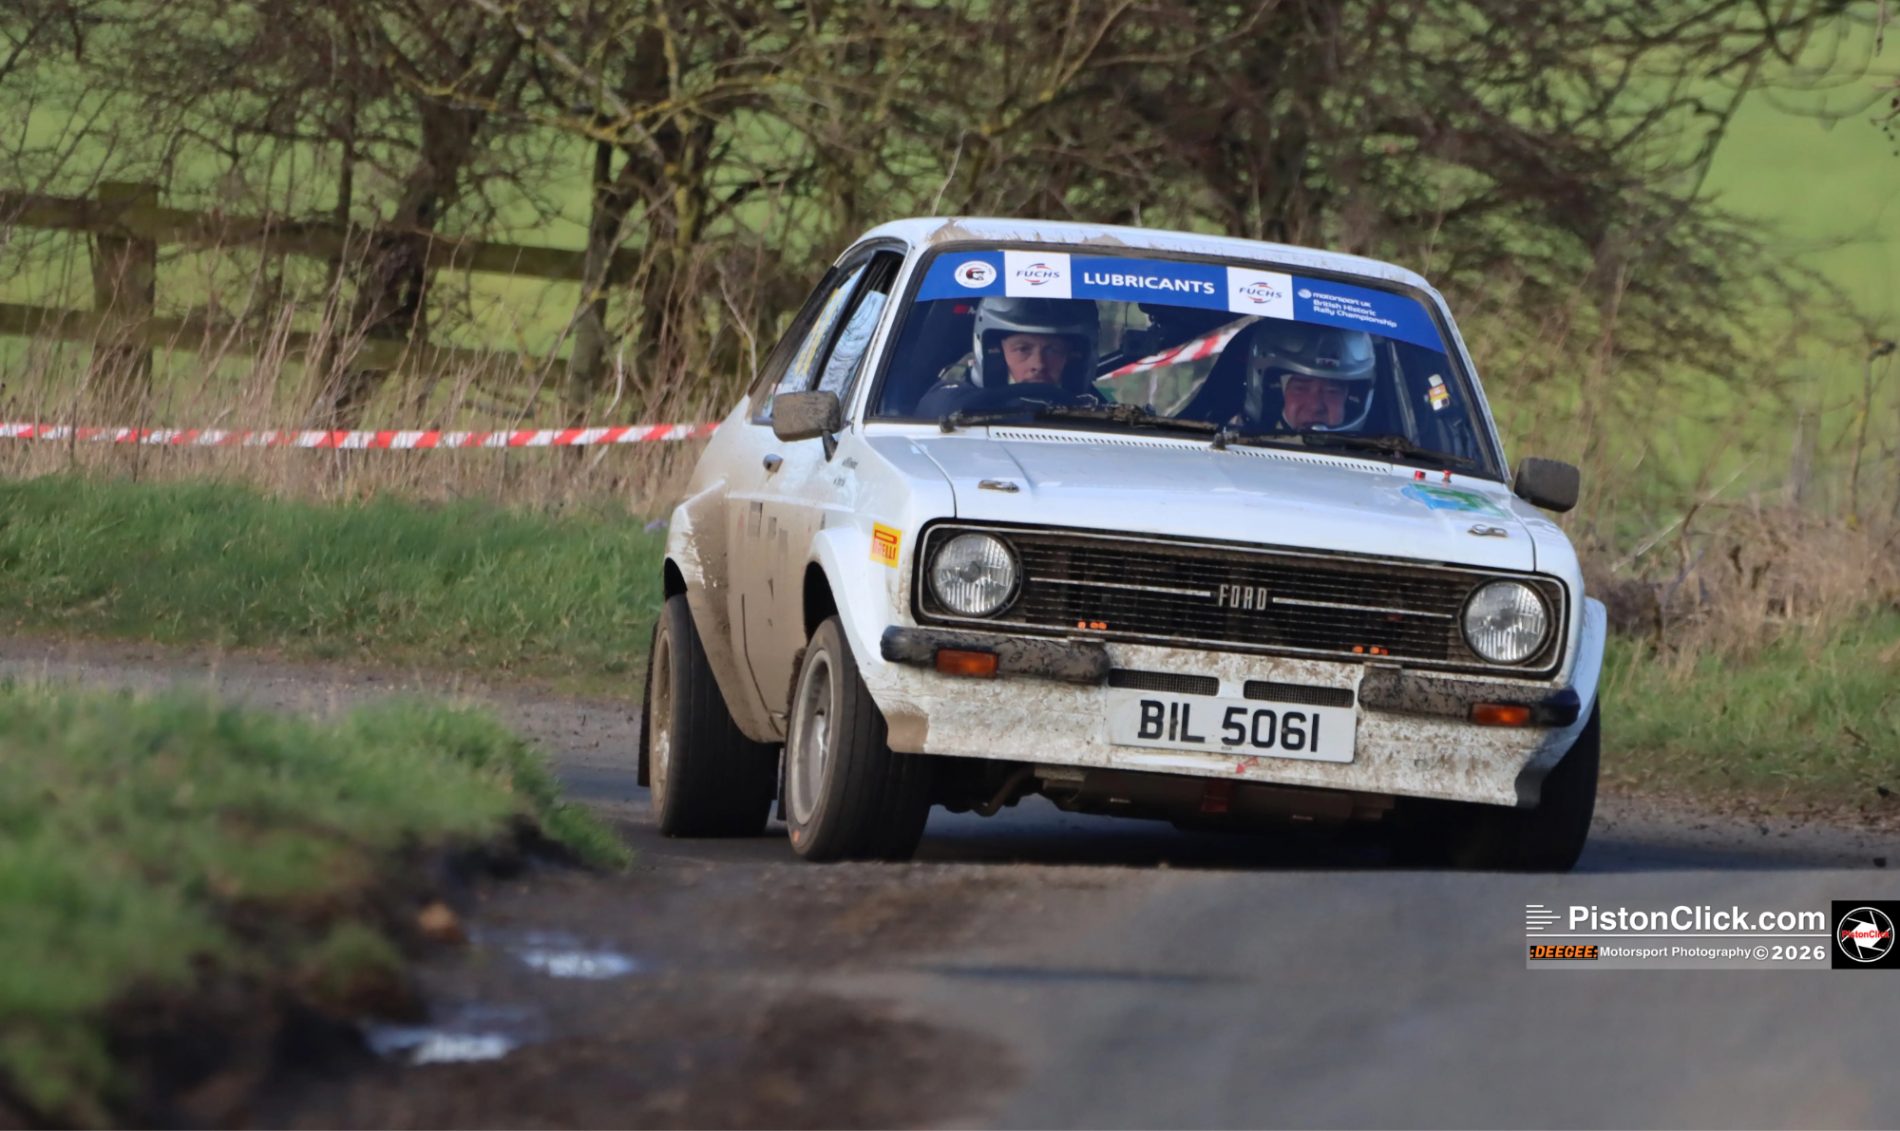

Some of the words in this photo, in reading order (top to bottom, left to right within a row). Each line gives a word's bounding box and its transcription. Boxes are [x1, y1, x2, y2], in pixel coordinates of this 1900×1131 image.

[1016, 270, 1061, 279] FUCHS
[1084, 272, 1215, 295] LUBRICANTS
[1238, 286, 1283, 299] FUCHS
[1312, 292, 1359, 305] motorsport
[1313, 299, 1342, 310] British
[1343, 304, 1376, 317] Historic
[1313, 306, 1335, 316] Rally
[1336, 310, 1398, 328] Championship
[1218, 583, 1268, 610] FORD
[1137, 699, 1206, 744] BIL
[1221, 706, 1321, 753] 5061
